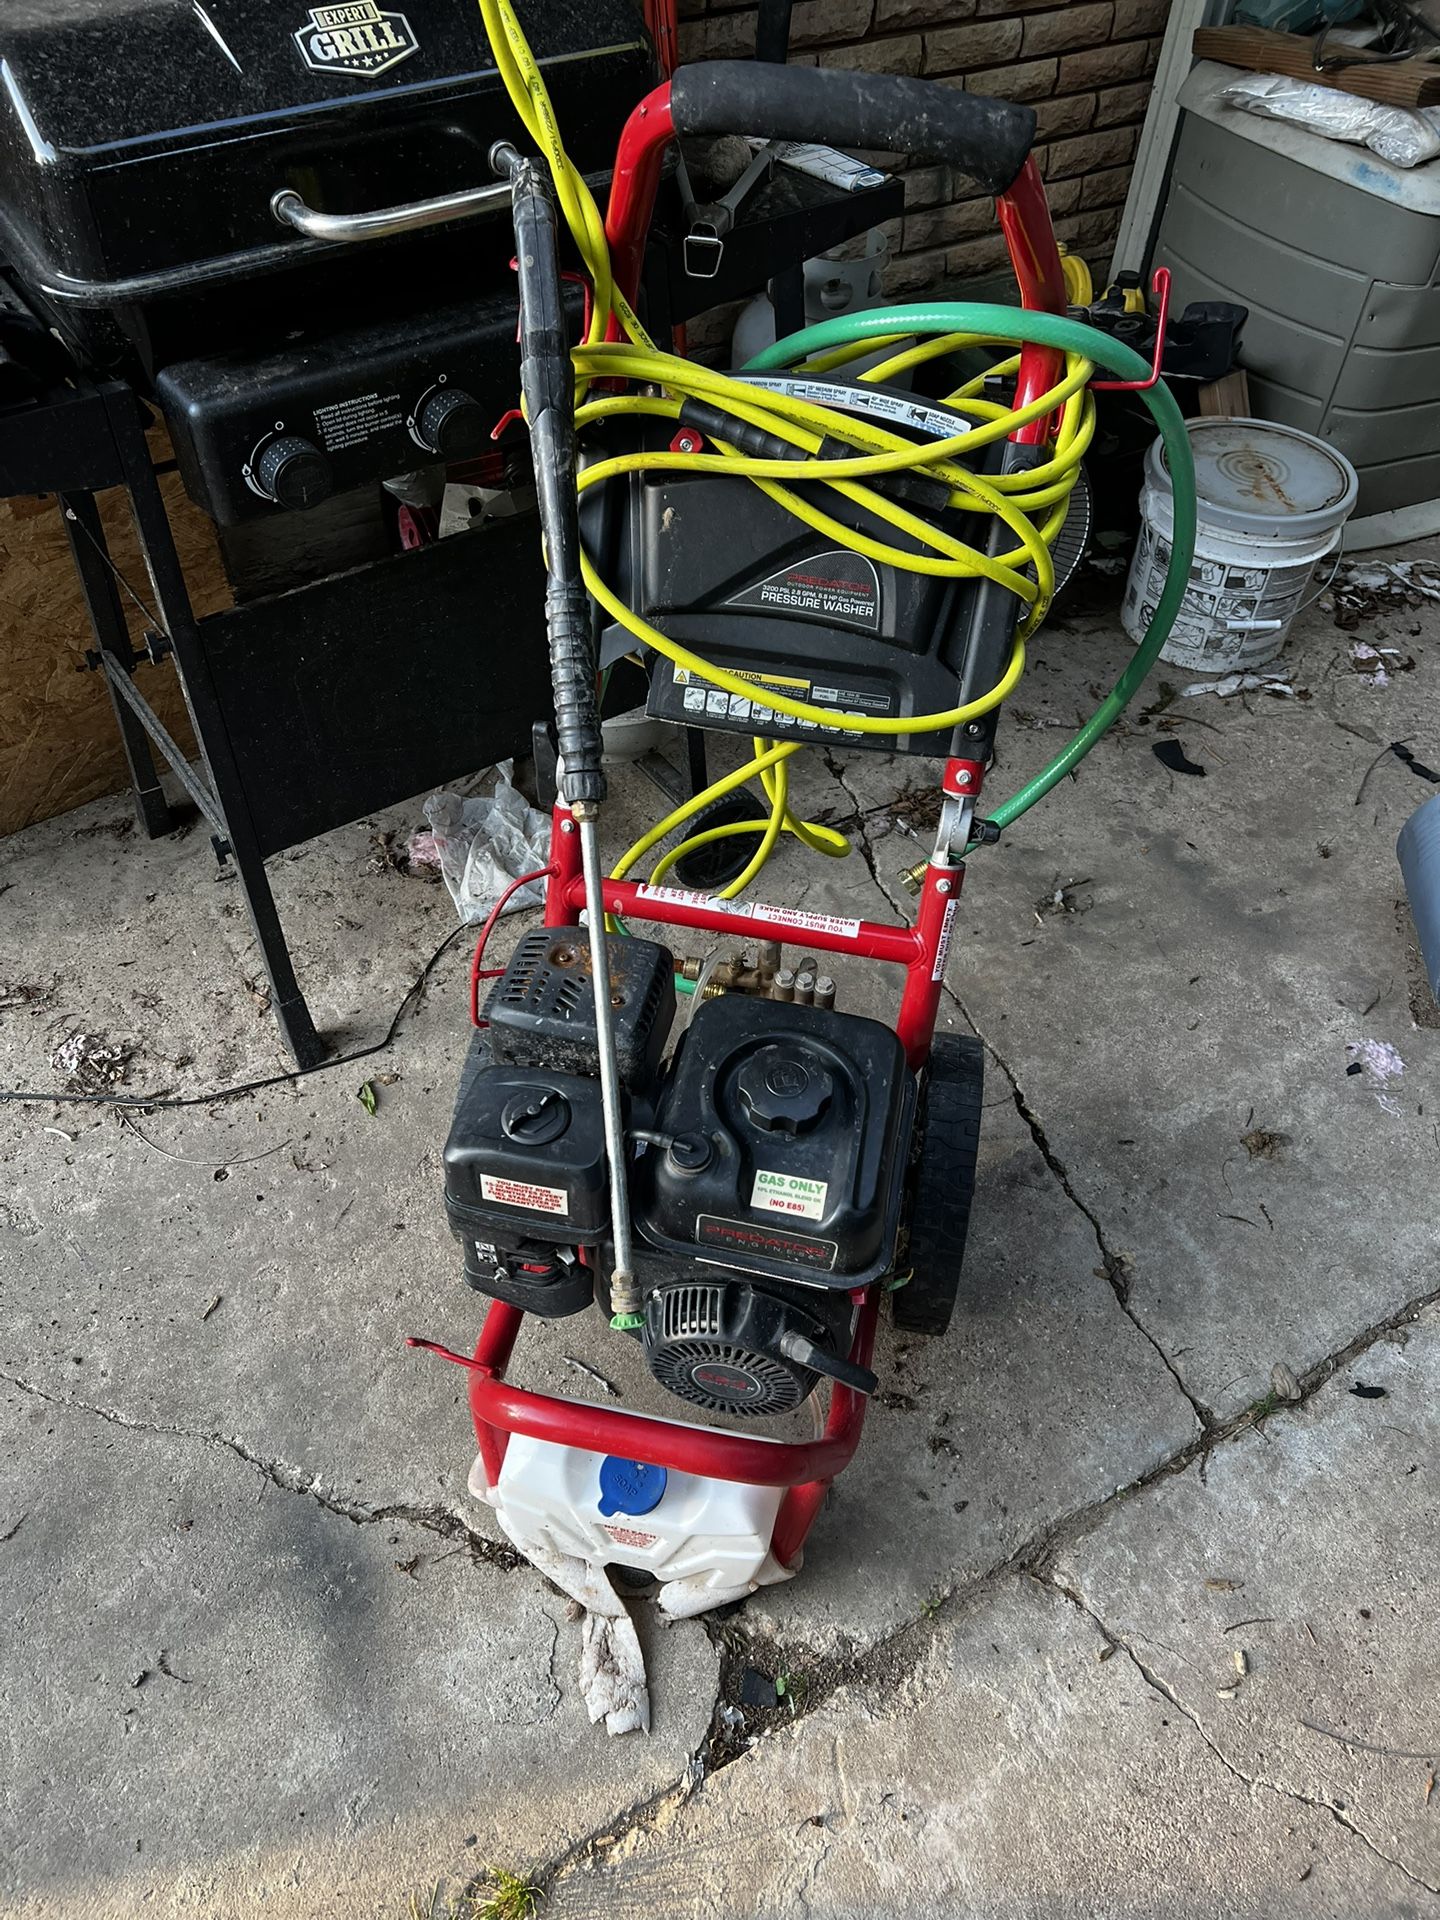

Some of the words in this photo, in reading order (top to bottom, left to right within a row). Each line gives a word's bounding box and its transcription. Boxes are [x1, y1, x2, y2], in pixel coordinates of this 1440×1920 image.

[324, 4, 367, 25] EXPERT
[310, 21, 407, 61] GRILL
[312, 404, 339, 416] LIGHTING
[338, 393, 378, 408] INSTRUCTIONS
[340, 404, 368, 415] instructions
[368, 399, 383, 407] before
[890, 400, 904, 408] SPRAY
[364, 420, 380, 428] burner
[940, 416, 955, 425] NOZZLE
[786, 581, 814, 589] OUTDOOR
[815, 585, 836, 593] POWER
[837, 588, 870, 598] EQUIPMENT
[788, 572, 871, 593] PREDATOR
[762, 584, 779, 593] 3200
[850, 598, 875, 607] Powered
[761, 590, 821, 609] PRESSURE
[823, 600, 874, 617] WASHER
[728, 670, 762, 681] CAUTION
[760, 906, 781, 914] MAKE
[799, 913, 828, 922] SUPPLY
[767, 913, 804, 926] CONNECT
[805, 921, 826, 931] MUST
[829, 918, 856, 927] WATER
[828, 924, 844, 933] YOU
[936, 936, 947, 956] MUST
[943, 907, 953, 933] EMPTY
[758, 1173, 786, 1188] GAS
[789, 1180, 825, 1195] ONLY
[495, 1188, 526, 1197] MONTHS
[505, 1186, 538, 1197] MINUTES
[540, 1193, 564, 1201] EVERY
[507, 1194, 550, 1206] STABILIZER
[769, 1188, 794, 1199] ETHANOL
[495, 1196, 535, 1207] WARRANTY
[769, 1198, 785, 1208] (NO
[786, 1202, 805, 1213] E85)
[704, 1224, 827, 1258] PREDATOR
[726, 1237, 806, 1258] ENGINES
[613, 1473, 638, 1497] SOAP
